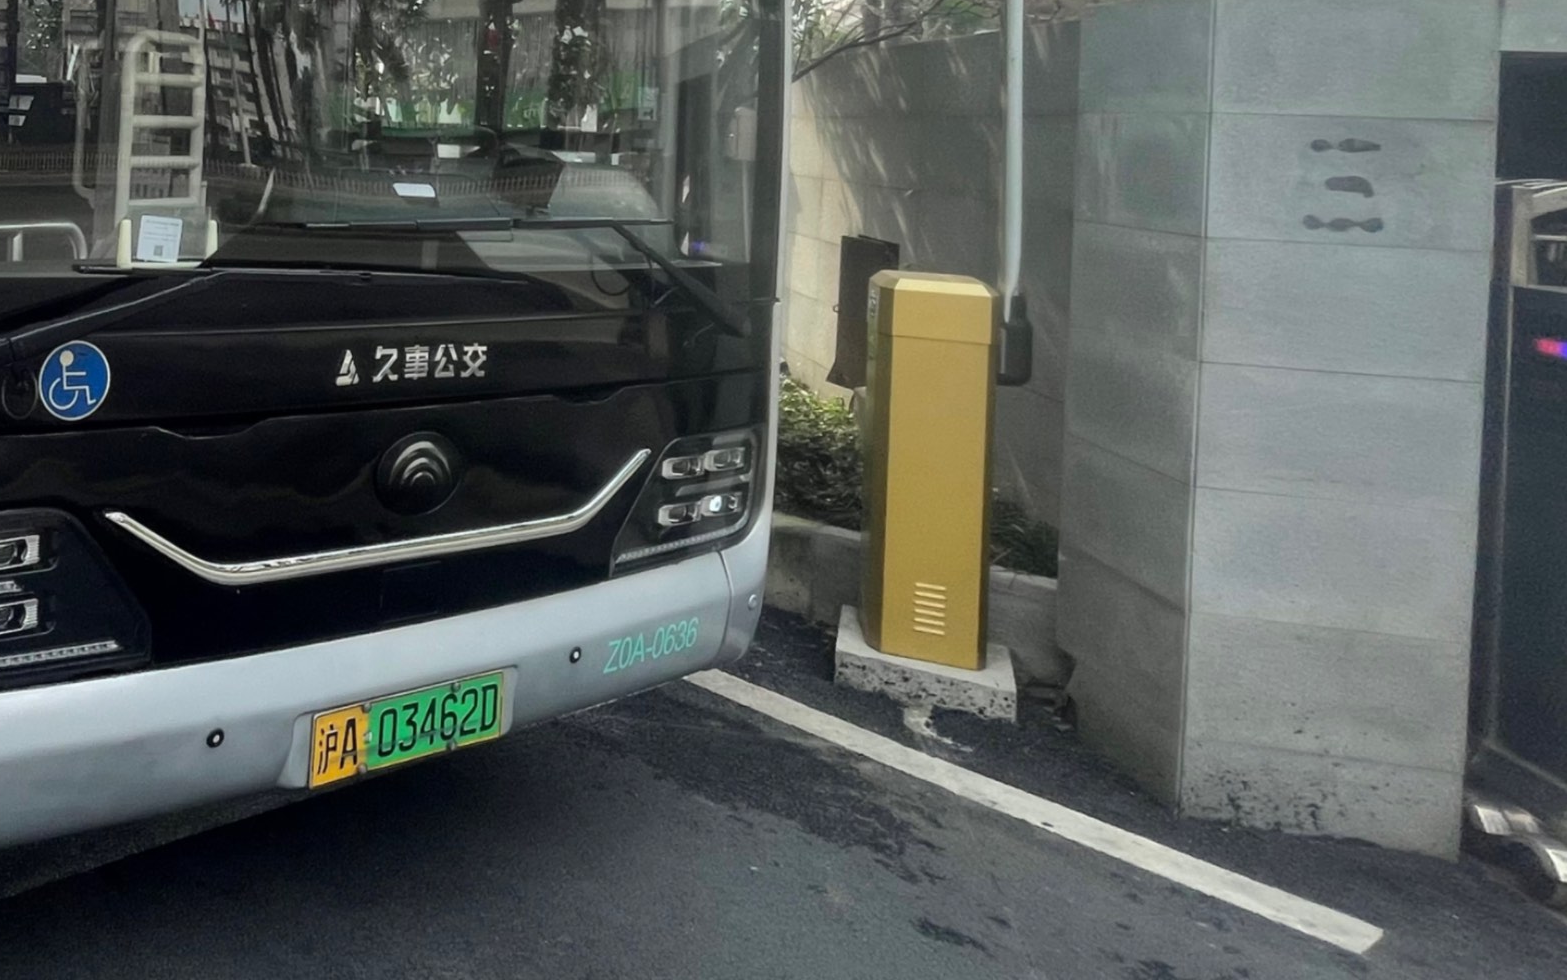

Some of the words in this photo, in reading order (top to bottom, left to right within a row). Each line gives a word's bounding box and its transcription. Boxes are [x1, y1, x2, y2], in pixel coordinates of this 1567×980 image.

[372, 342, 488, 383] 久事公交
[377, 684, 499, 757] 03462D
